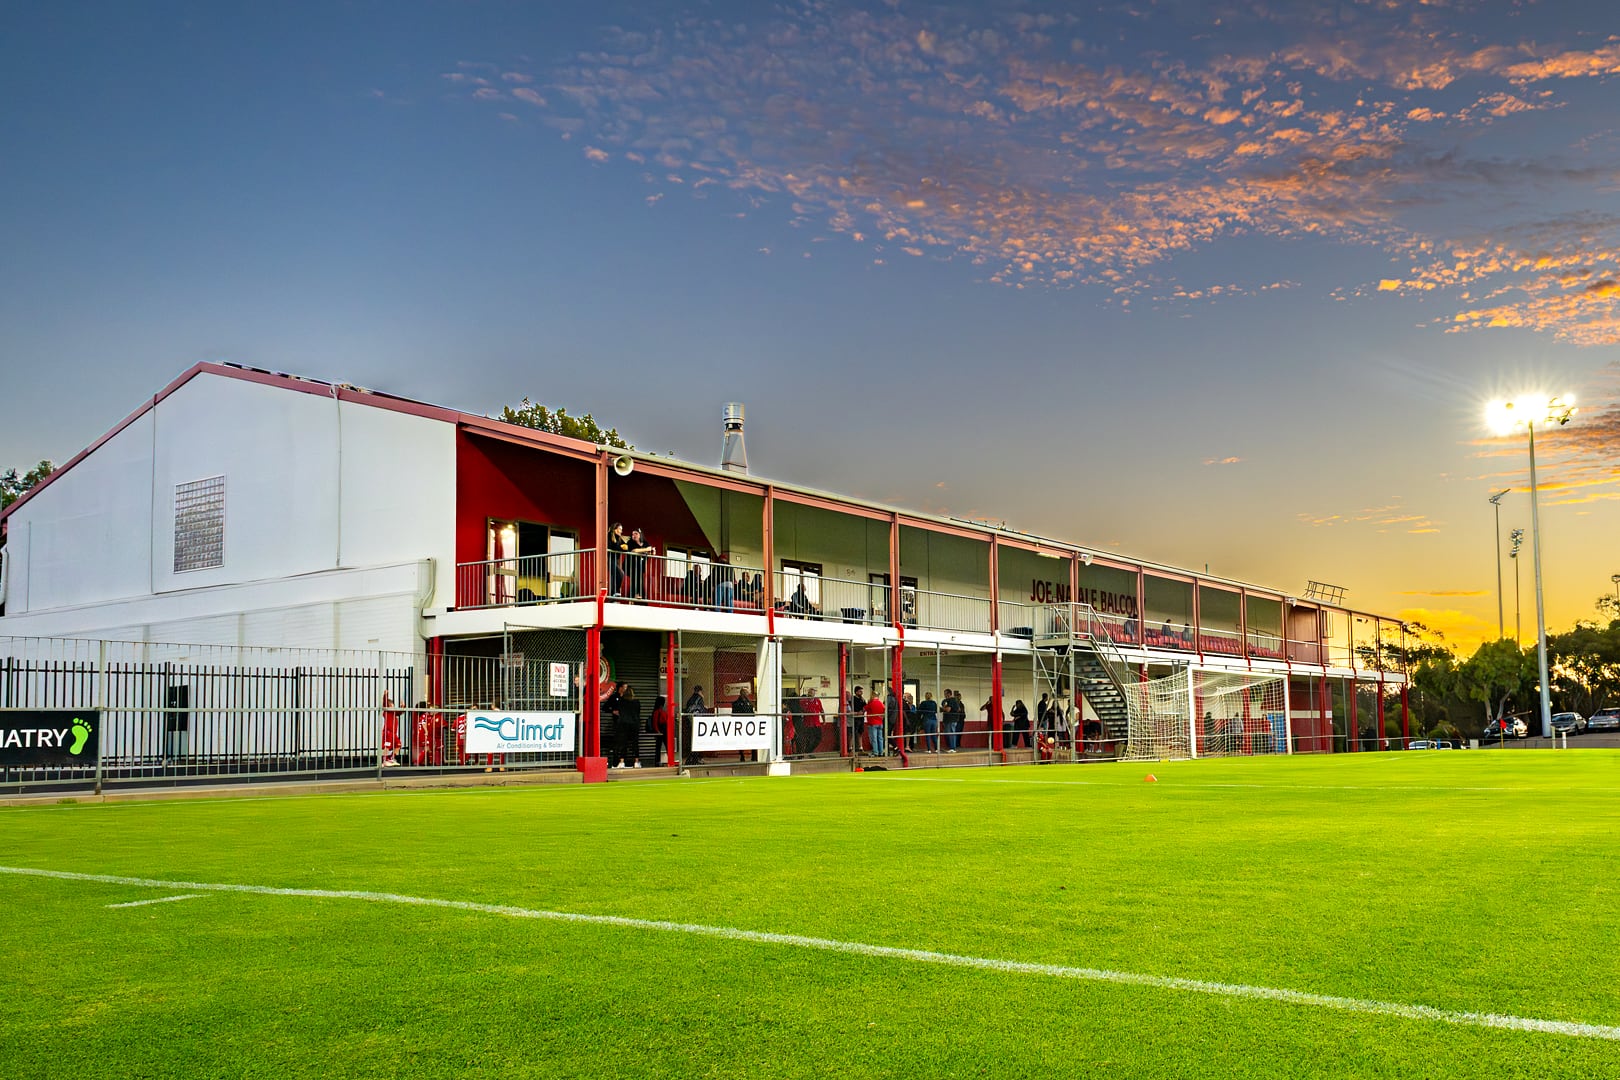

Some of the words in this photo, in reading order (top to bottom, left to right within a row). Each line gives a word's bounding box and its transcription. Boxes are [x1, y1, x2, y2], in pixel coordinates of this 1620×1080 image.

[1030, 579, 1053, 604] JOE
[1056, 583, 1097, 611] NAALE
[554, 665, 566, 674] NO
[498, 716, 564, 741] Climat
[697, 720, 767, 737] DAVROE
